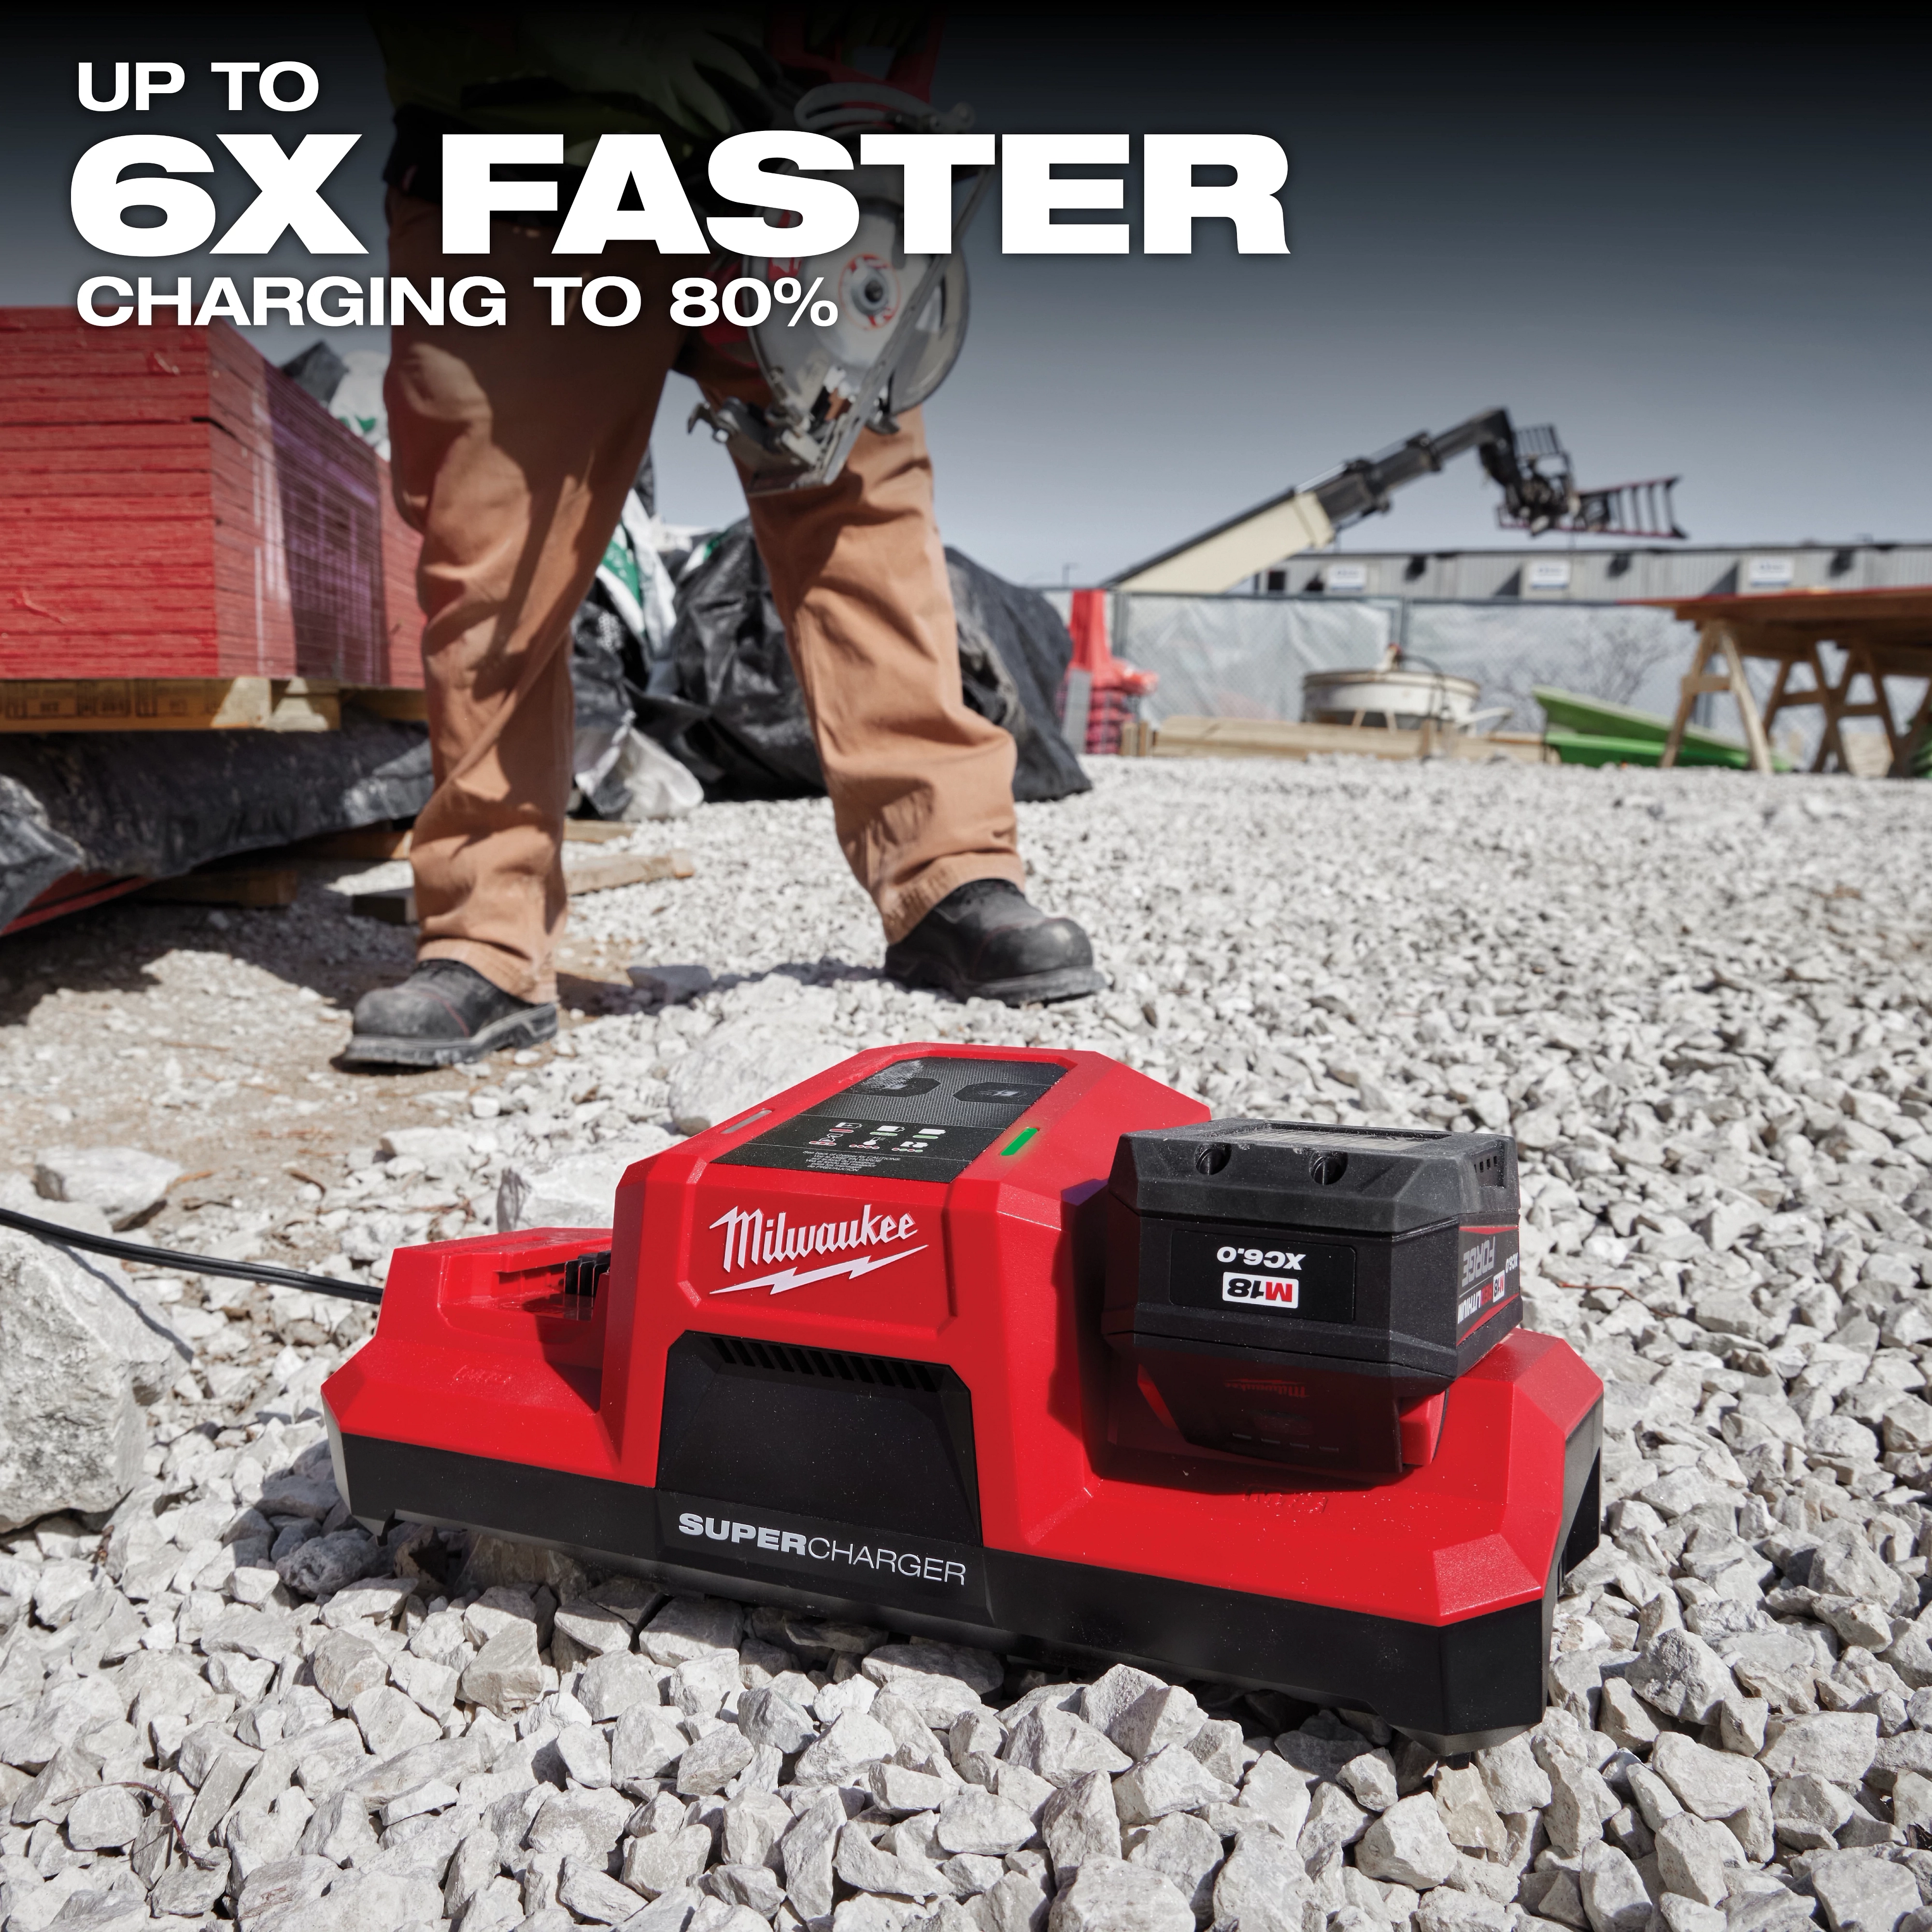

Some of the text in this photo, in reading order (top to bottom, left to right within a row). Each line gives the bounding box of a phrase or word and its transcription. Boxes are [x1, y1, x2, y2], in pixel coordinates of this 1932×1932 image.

[710, 1205, 918, 1273] Milwaukee
[1217, 1246, 1306, 1270] XC6.0
[1462, 1236, 1495, 1287] FORGE
[1506, 1252, 1519, 1274] XC6.0
[1227, 1278, 1293, 1303] M18
[1494, 1275, 1504, 1298] M18
[679, 1513, 966, 1585] SUPERCHARGER
